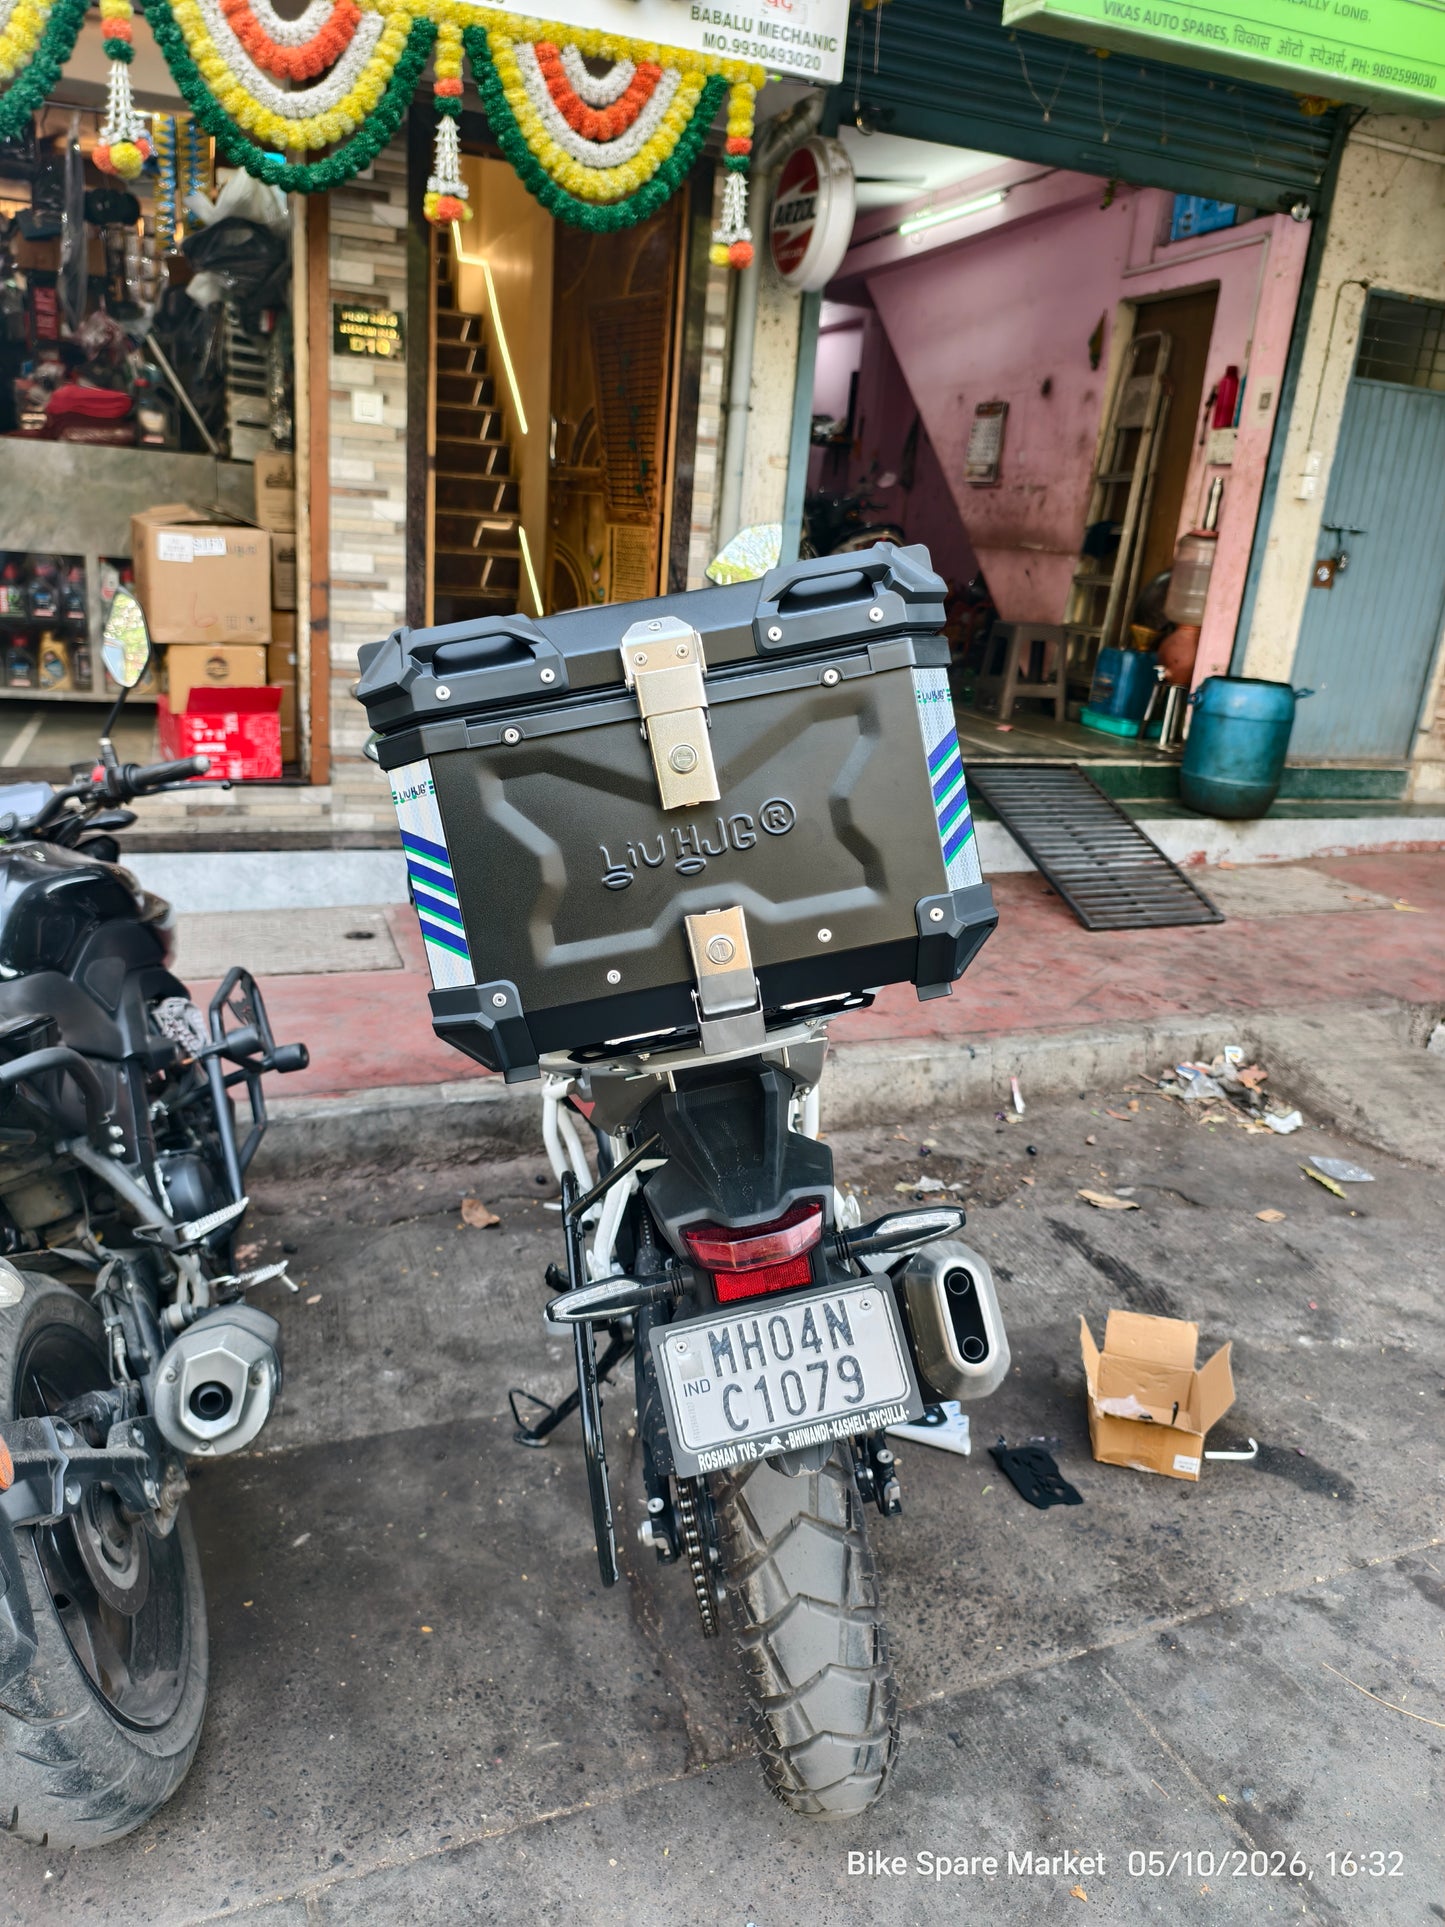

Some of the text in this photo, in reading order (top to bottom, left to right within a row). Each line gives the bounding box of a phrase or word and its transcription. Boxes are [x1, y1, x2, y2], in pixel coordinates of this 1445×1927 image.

[691, 5, 753, 32] BABALU
[758, 20, 838, 52] MECHANIC
[1334, 2, 1372, 22] LONG.
[703, 32, 821, 71] MO.9930493020
[1103, 1, 1140, 21] VIKAS
[1143, 10, 1179, 30] AUTO
[1182, 18, 1230, 44] SPARES,
[1233, 24, 1272, 51] विकास
[1351, 57, 1369, 75] PH:
[1372, 63, 1438, 89] 9892599030
[707, 1299, 855, 1378] MH04N
[682, 1378, 711, 1398] IND
[722, 1355, 866, 1432] C1079
[697, 1448, 738, 1472] ROSHAN
[739, 1442, 759, 1462] TVS
